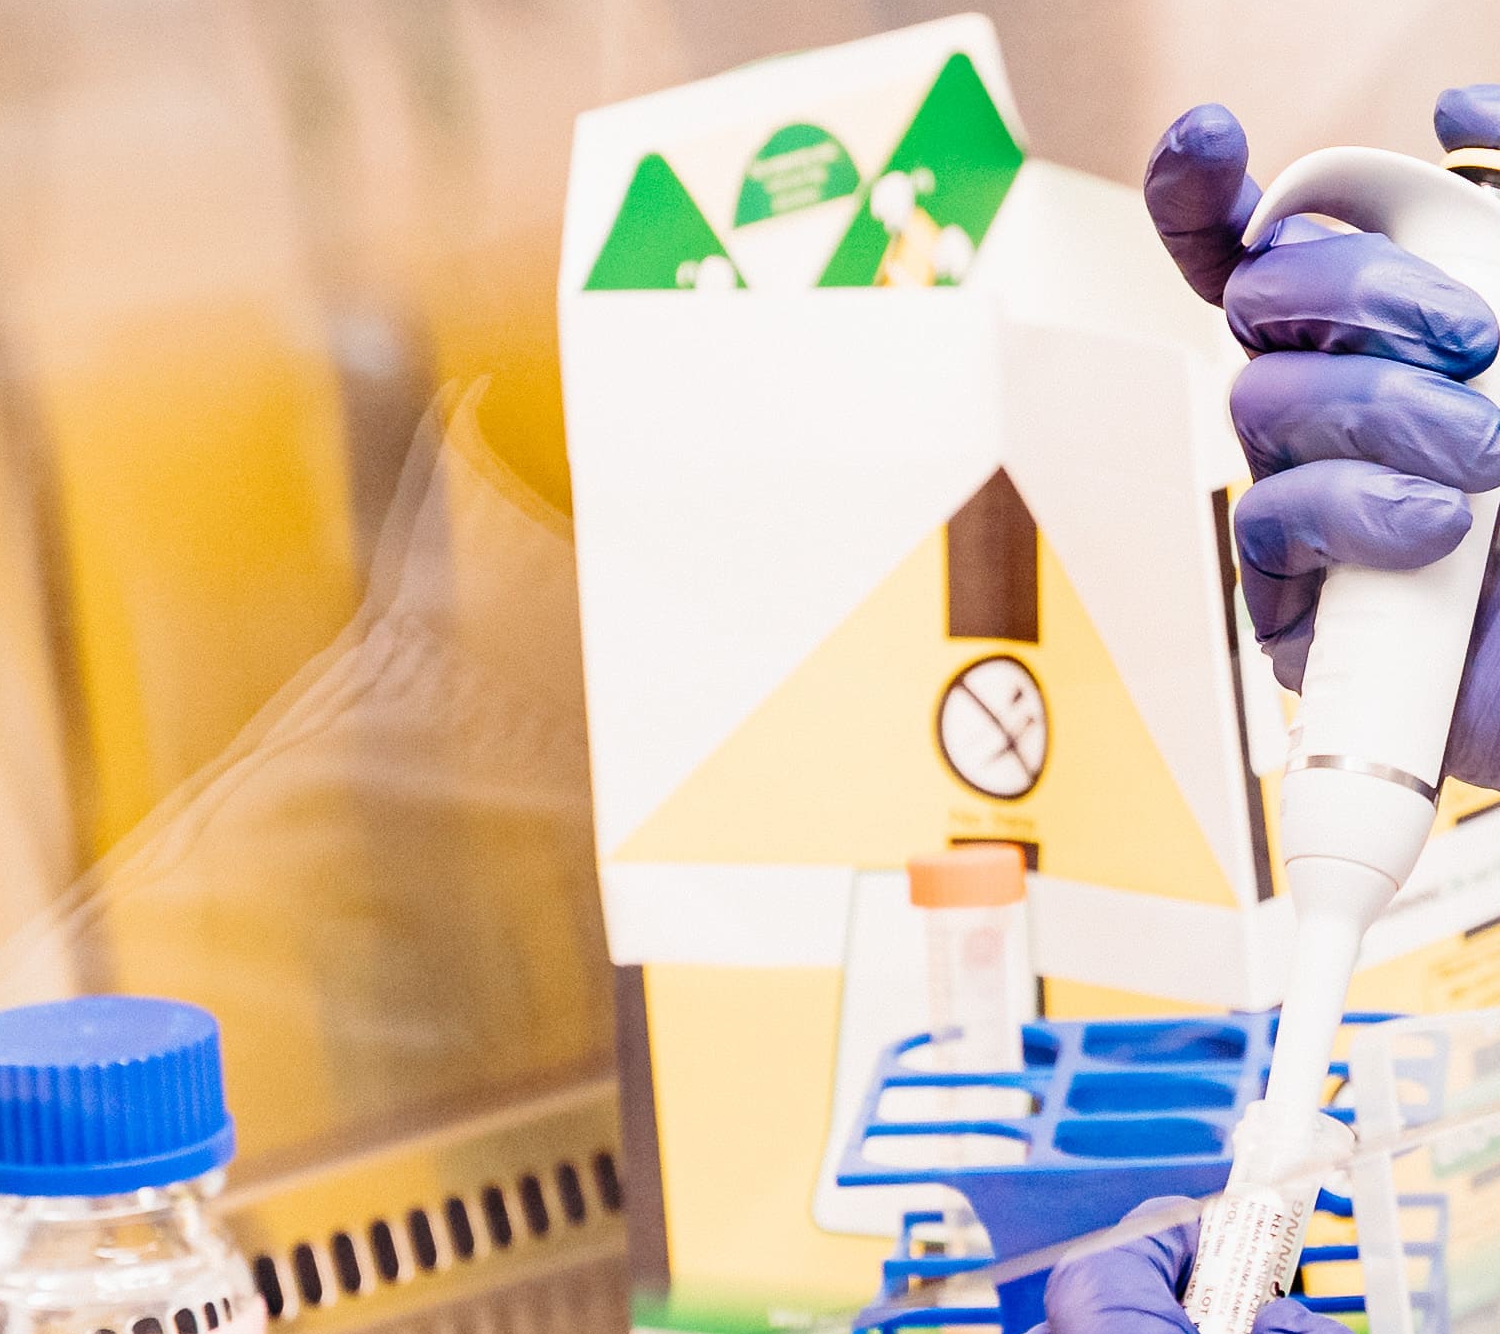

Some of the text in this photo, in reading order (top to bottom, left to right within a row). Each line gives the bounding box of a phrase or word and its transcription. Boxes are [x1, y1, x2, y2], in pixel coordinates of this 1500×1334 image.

[1227, 1200, 1241, 1228] VOL
[1265, 1199, 1305, 1305] ORNING
[1200, 1285, 1214, 1316] LOT
